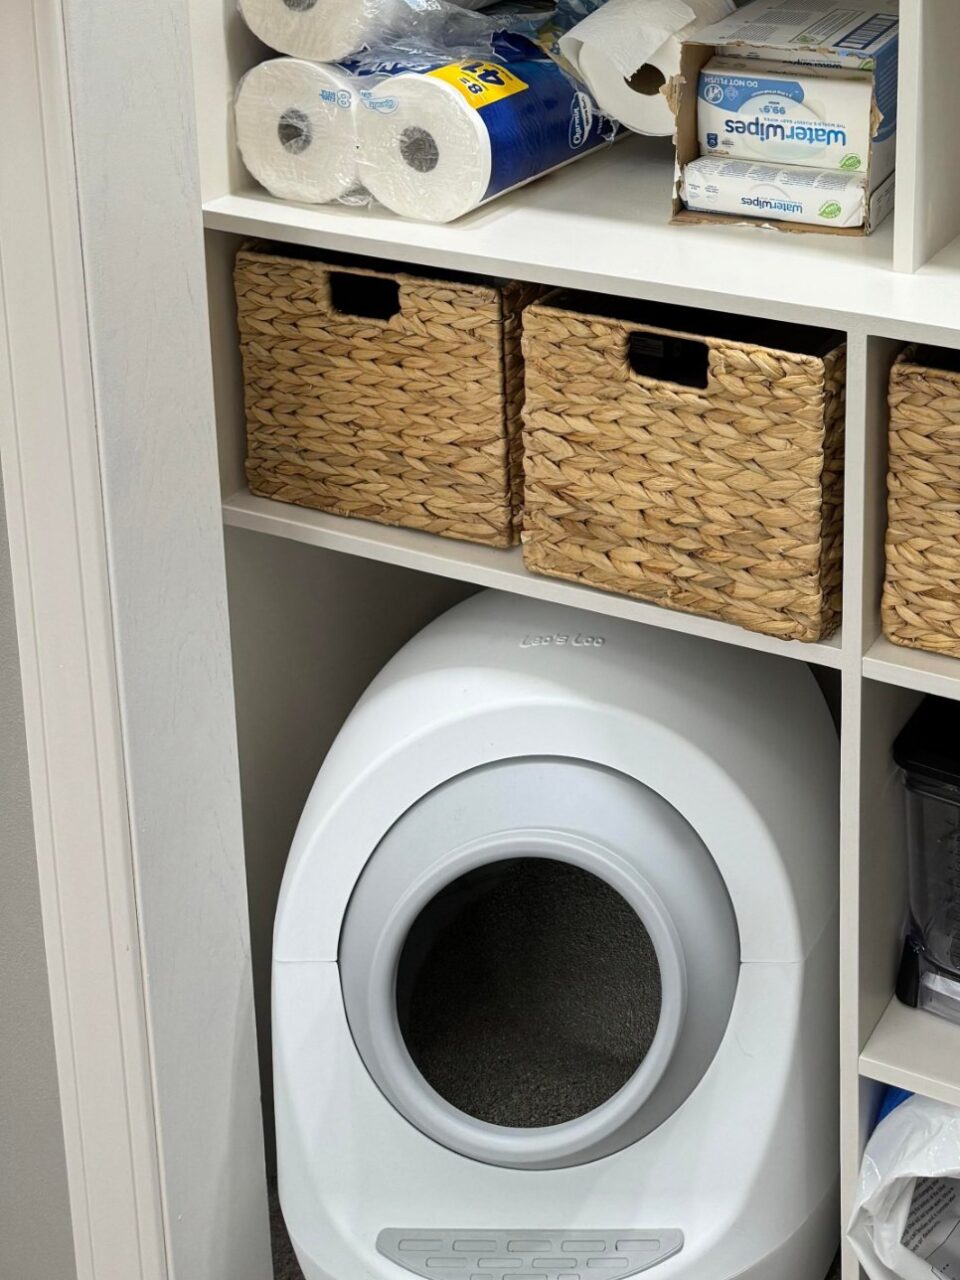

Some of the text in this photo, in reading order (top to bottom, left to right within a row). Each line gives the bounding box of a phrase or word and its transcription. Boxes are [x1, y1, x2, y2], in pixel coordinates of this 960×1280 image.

[467, 83, 483, 95] 8
[704, 76, 758, 88] DO NOT FLUSH
[336, 89, 352, 109] 8
[571, 104, 581, 145] Charmin
[725, 116, 847, 147] WaterWipes
[740, 196, 803, 214] WaterWipes
[518, 632, 607, 649] Leo's Loo
